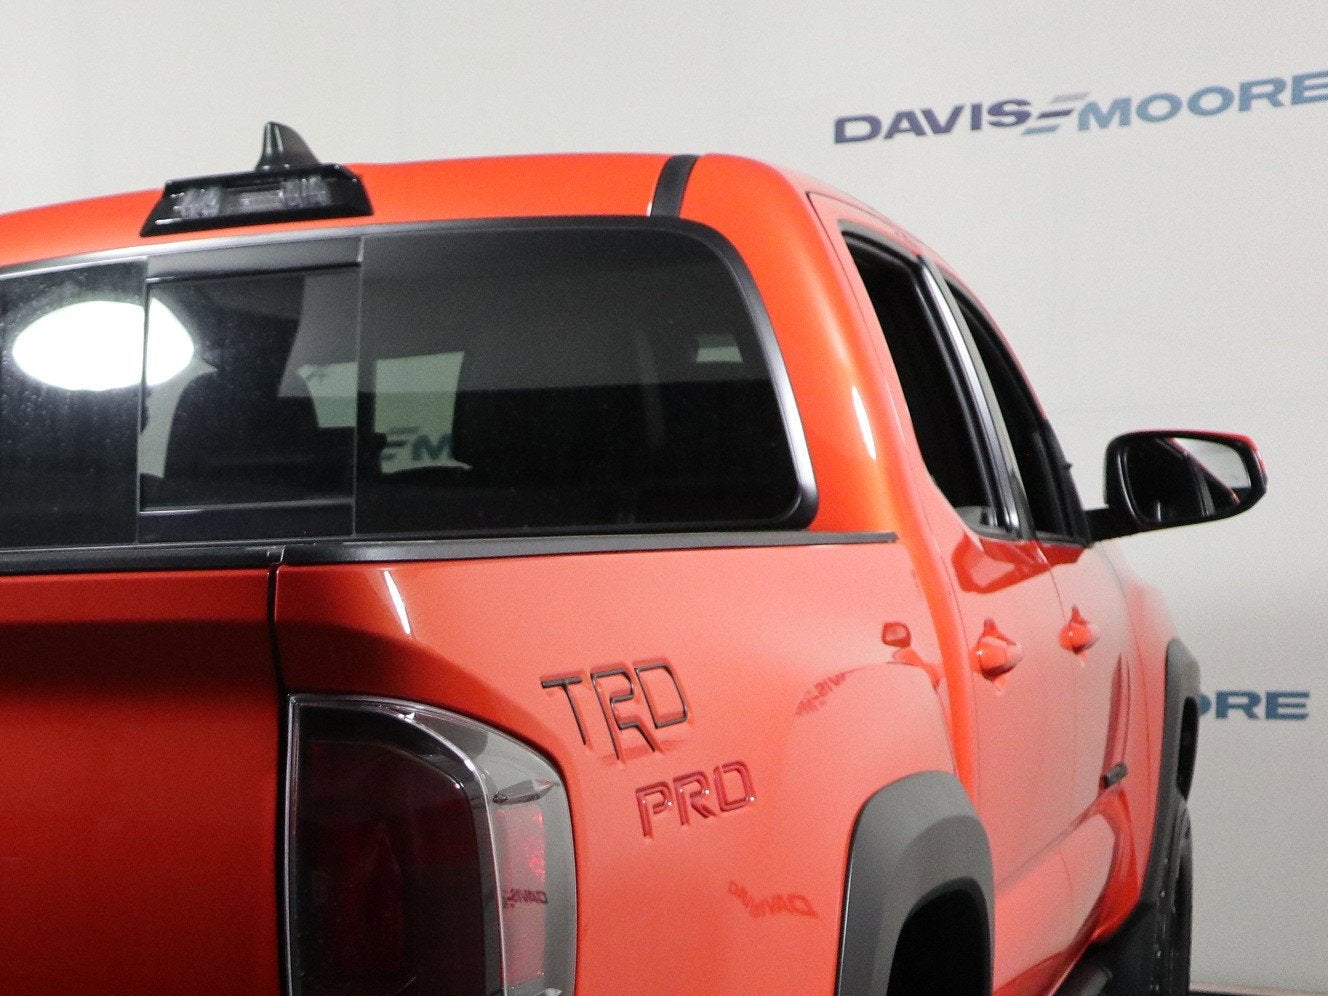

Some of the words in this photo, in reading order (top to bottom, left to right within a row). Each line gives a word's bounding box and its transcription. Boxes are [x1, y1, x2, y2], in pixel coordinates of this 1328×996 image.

[834, 98, 1032, 144] DAVIS
[1077, 70, 1328, 132] MOORE
[540, 660, 690, 761] TRD
[1197, 689, 1311, 720] RE
[635, 760, 757, 838] PRO
